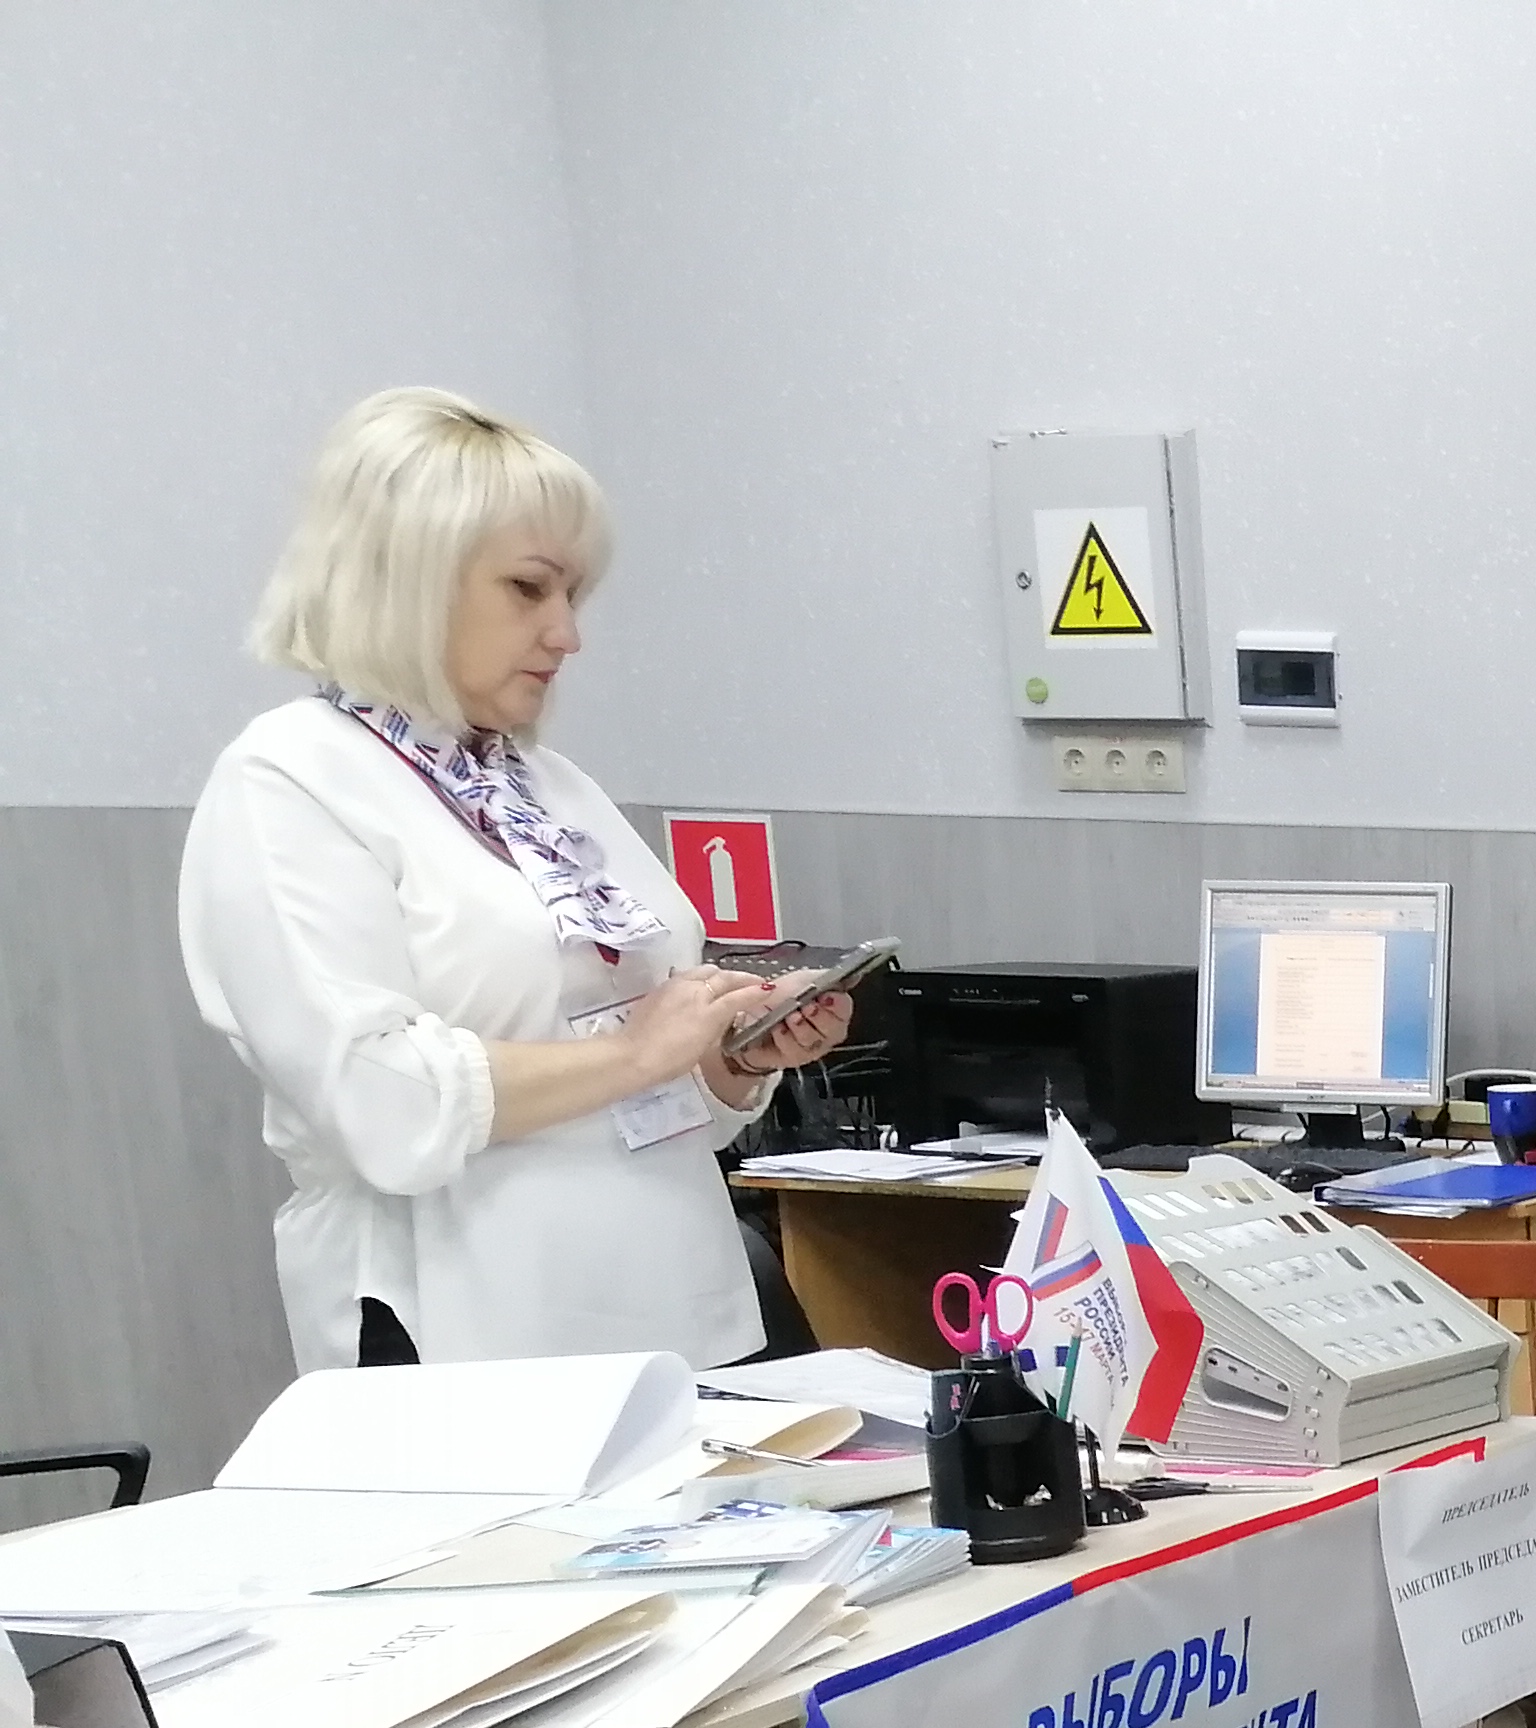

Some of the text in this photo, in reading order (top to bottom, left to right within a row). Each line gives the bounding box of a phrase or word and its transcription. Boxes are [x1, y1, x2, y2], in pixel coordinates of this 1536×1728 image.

[1073, 1296, 1116, 1360] РОССИИ
[1089, 1342, 1115, 1385] МАРТА
[1441, 1482, 1530, 1524] ПРЕДСЕДАТЕЛЬ
[1395, 1560, 1475, 1604] ЗАМЕСТИТЕЛЬ
[1461, 1608, 1524, 1646] СЕКРЕТАРЬ
